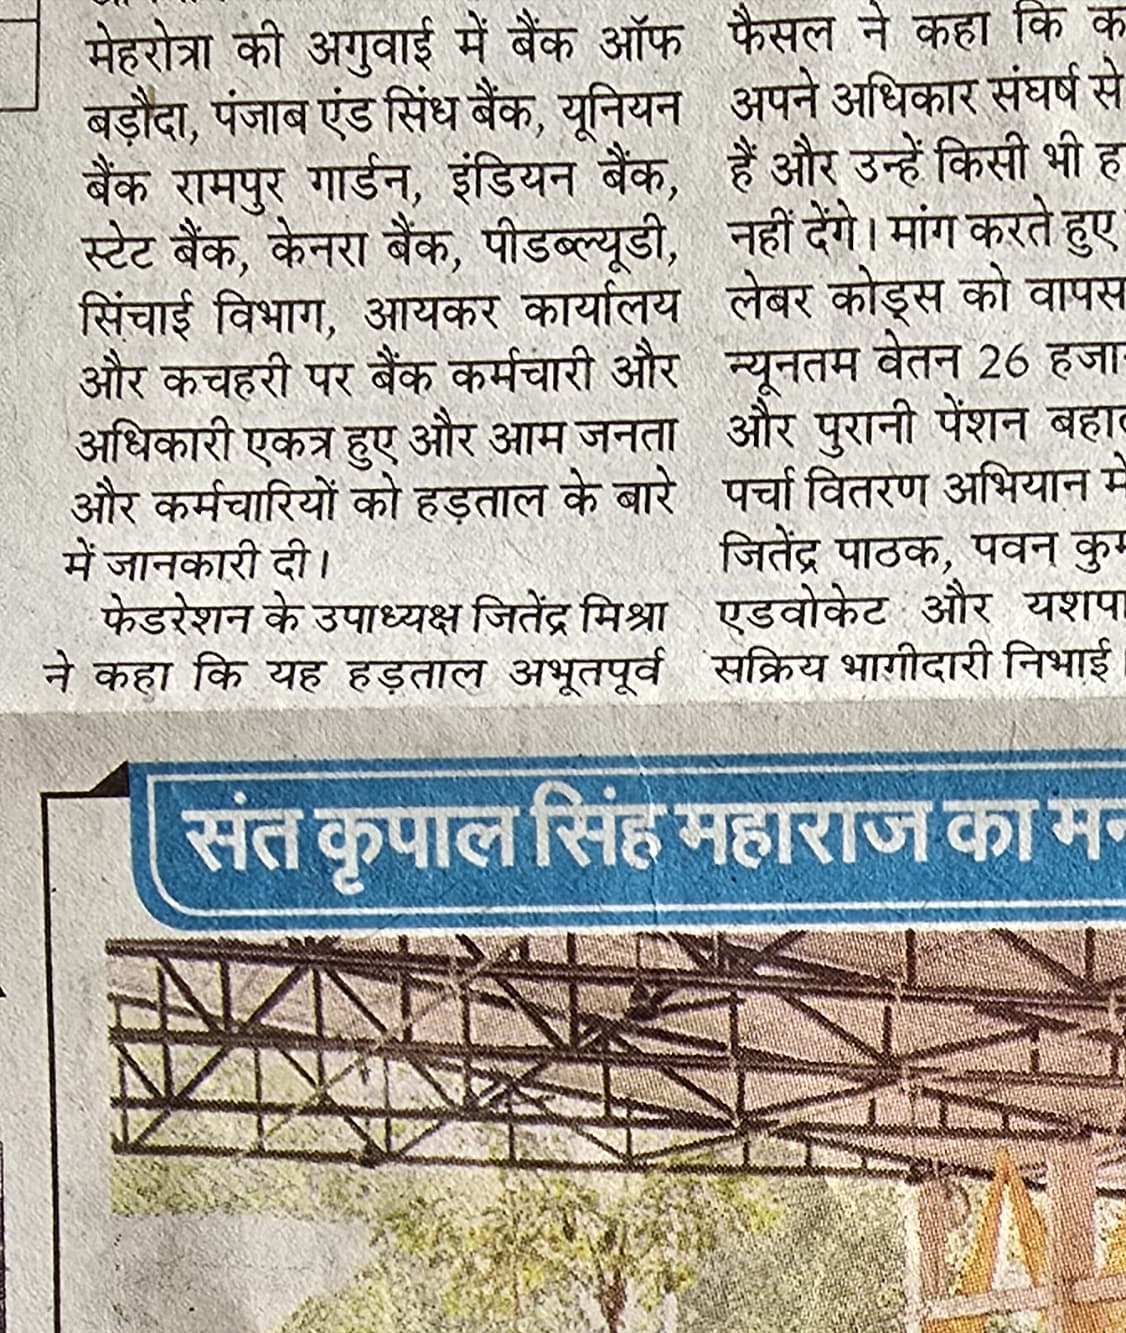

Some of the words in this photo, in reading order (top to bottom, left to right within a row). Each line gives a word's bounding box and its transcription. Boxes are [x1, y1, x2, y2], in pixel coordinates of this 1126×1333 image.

[84, 18, 214, 74] मेहरोत्रा
[232, 11, 285, 69] की
[308, 16, 435, 78] अगुवाई
[454, 9, 488, 64] में
[507, 8, 578, 63] बैंक
[599, 14, 685, 61] ऑफ
[726, 206, 794, 258] नहीं
[889, 206, 957, 252] मांग
[967, 194, 1056, 249] करते
[1061, 210, 1118, 250] हुए
[63, 538, 95, 582] में
[105, 538, 263, 581] जानकारी
[719, 523, 821, 574] जितेंद्र
[834, 536, 953, 573] पाठक,
[970, 532, 1059, 567] पवन
[101, 592, 255, 636] फेडरेशन
[262, 590, 305, 634] के
[312, 604, 463, 636] उपाध्यक्ष
[471, 589, 572, 636] जितेंद्र
[579, 592, 669, 633] मिश्रा
[181, 791, 304, 872] संत
[313, 805, 520, 891] कृपाल
[529, 780, 668, 870] सिंह
[674, 800, 934, 869] महाराज
[942, 799, 1040, 862] का
